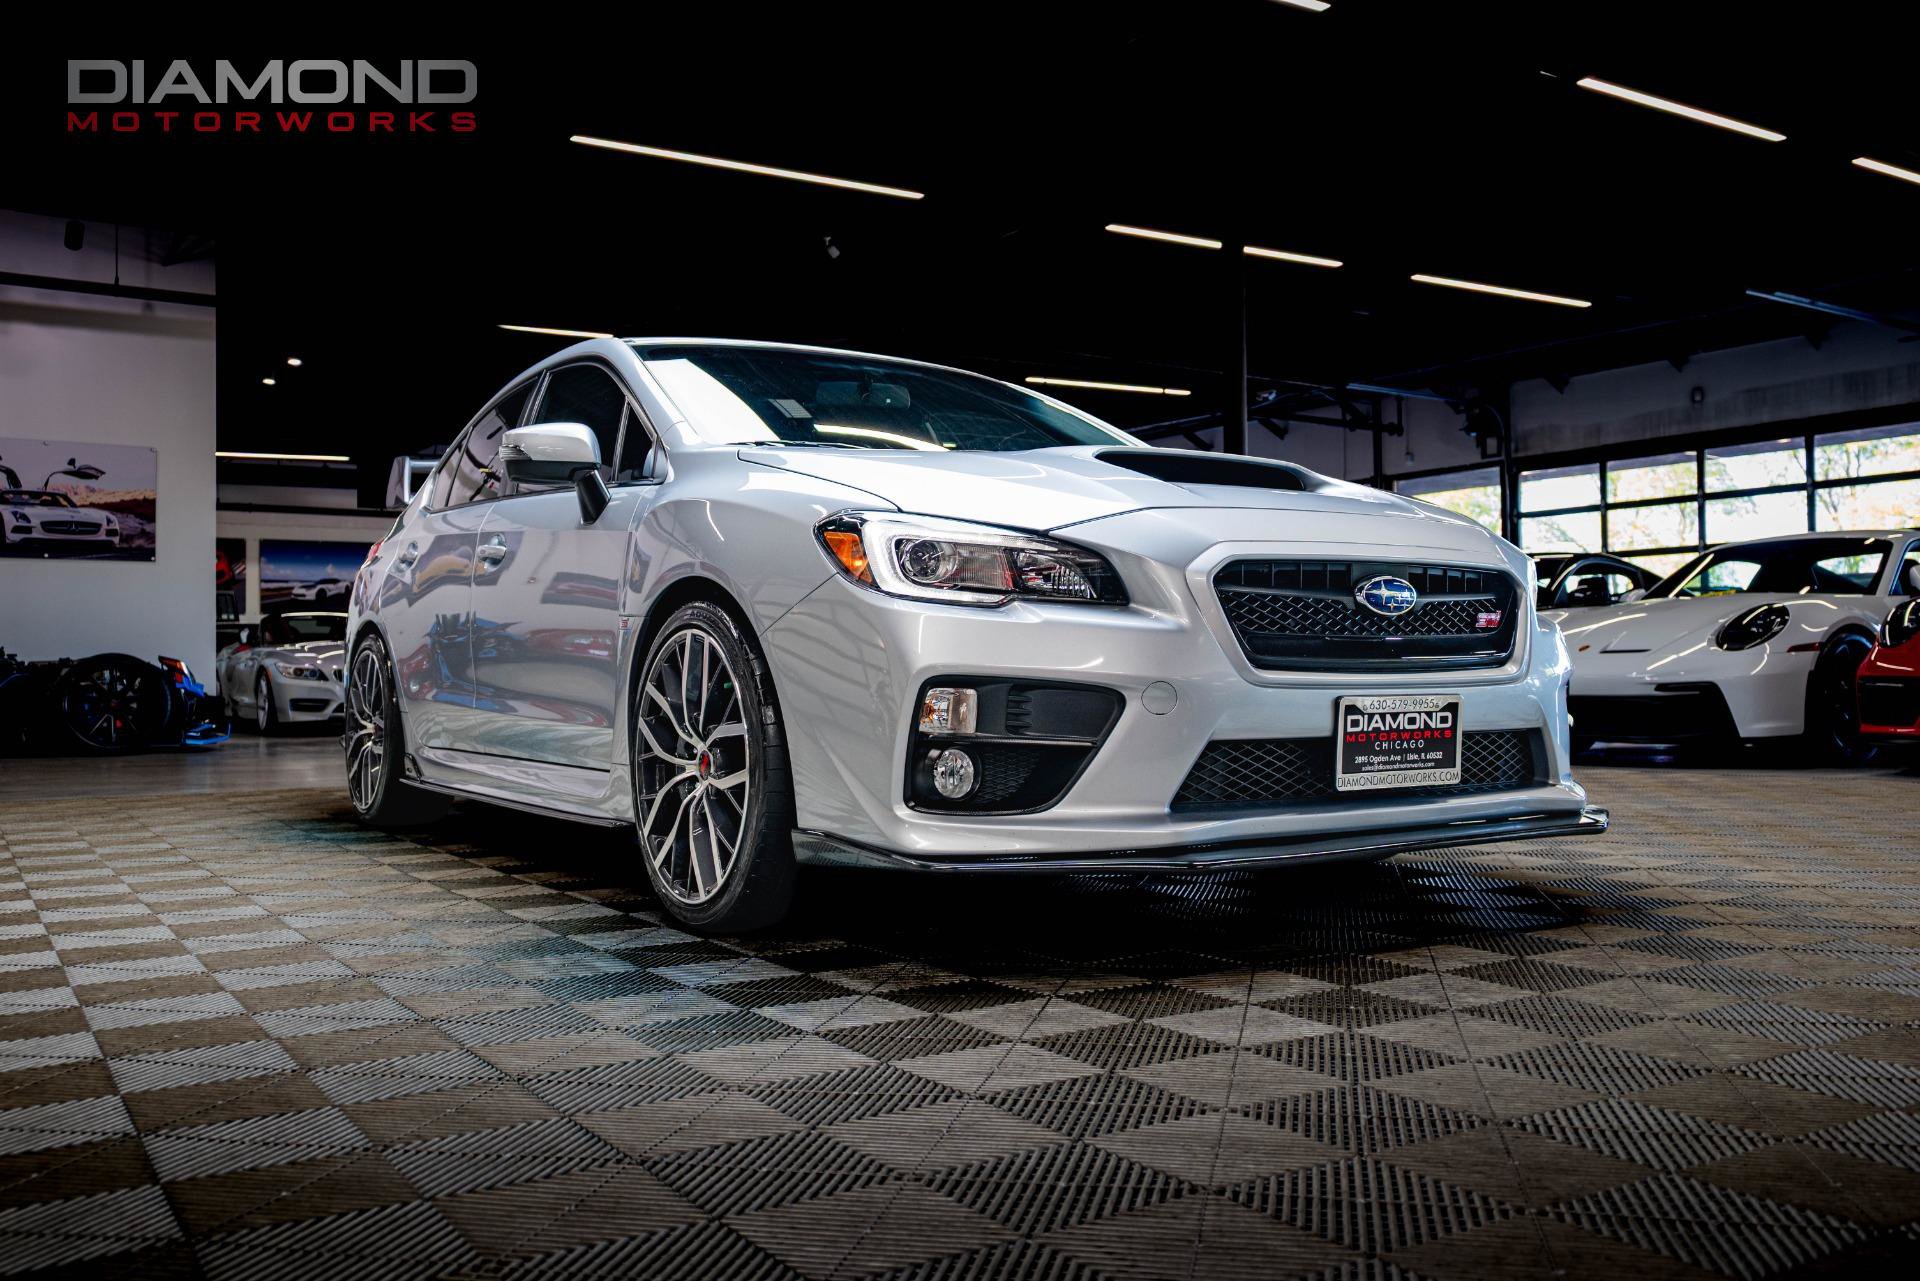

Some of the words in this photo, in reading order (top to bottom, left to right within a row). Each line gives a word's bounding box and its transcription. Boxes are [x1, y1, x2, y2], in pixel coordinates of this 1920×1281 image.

[1369, 699, 1435, 710] 630-579-9955
[1346, 711, 1452, 732] DIAMOND
[1345, 730, 1452, 742] MOTORWORKS
[1374, 740, 1425, 750] CHICAGO
[1369, 755, 1389, 764] Ogden
[1337, 771, 1459, 788] DIAMONDMOTORWORKS.COM
